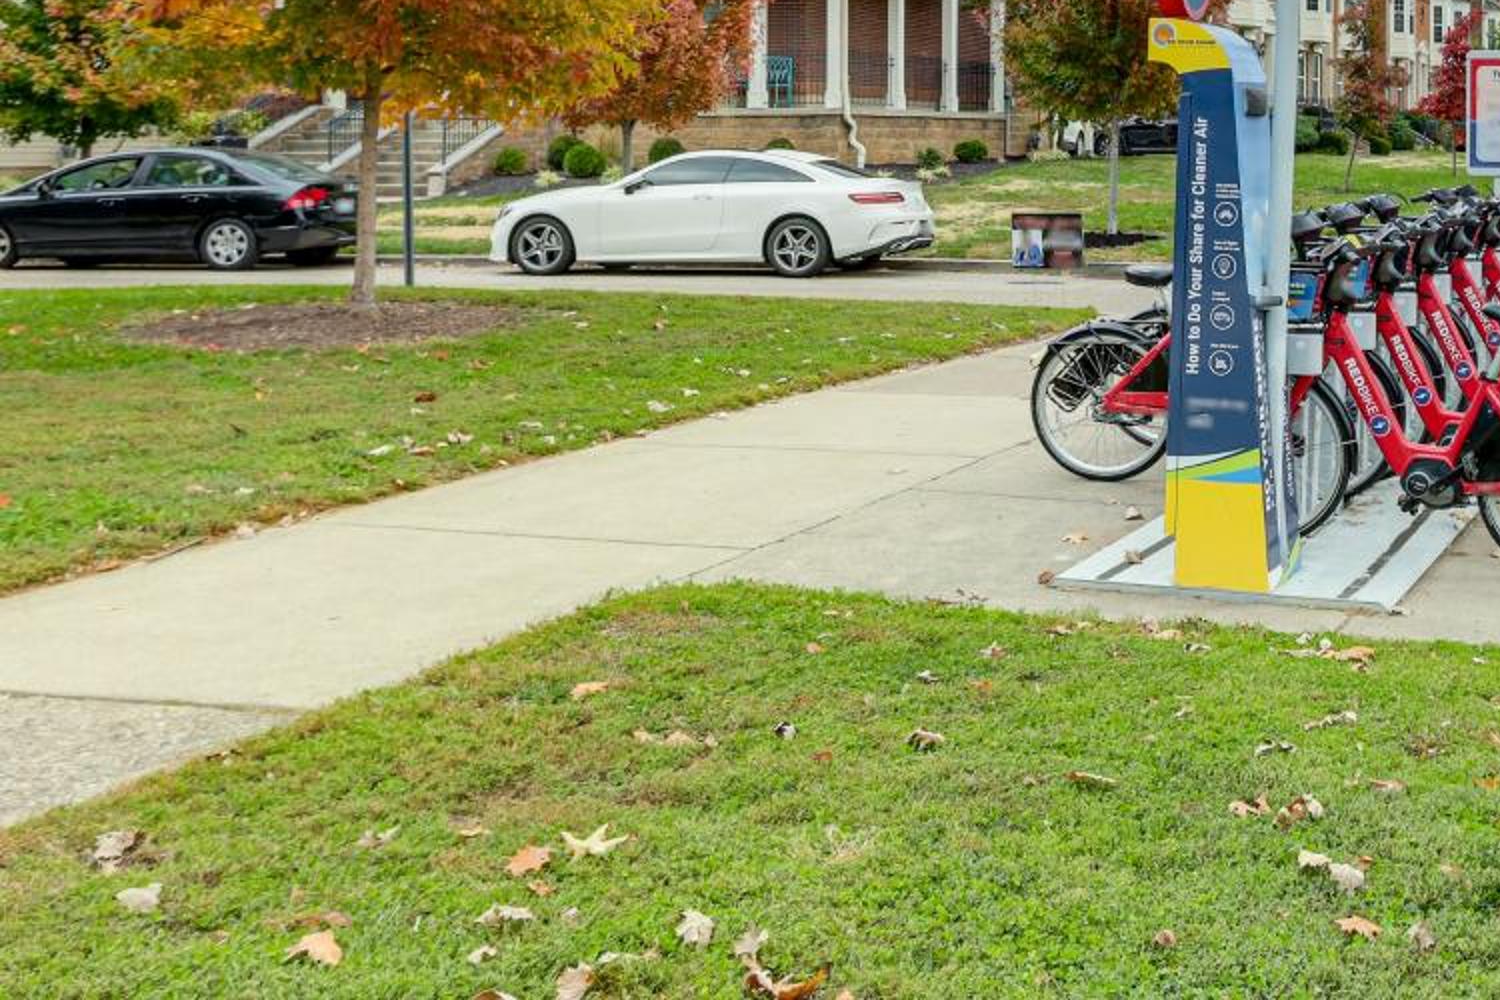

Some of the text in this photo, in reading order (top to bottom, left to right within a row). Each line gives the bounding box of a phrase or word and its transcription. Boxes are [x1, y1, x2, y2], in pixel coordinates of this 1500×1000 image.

[1185, 117, 1209, 375] How to Do Your Share for Cleaner Air
[1390, 334, 1423, 387] REDBIKE
[1431, 311, 1463, 360] REDBIKE
[1344, 357, 1379, 417] REDBIKE
